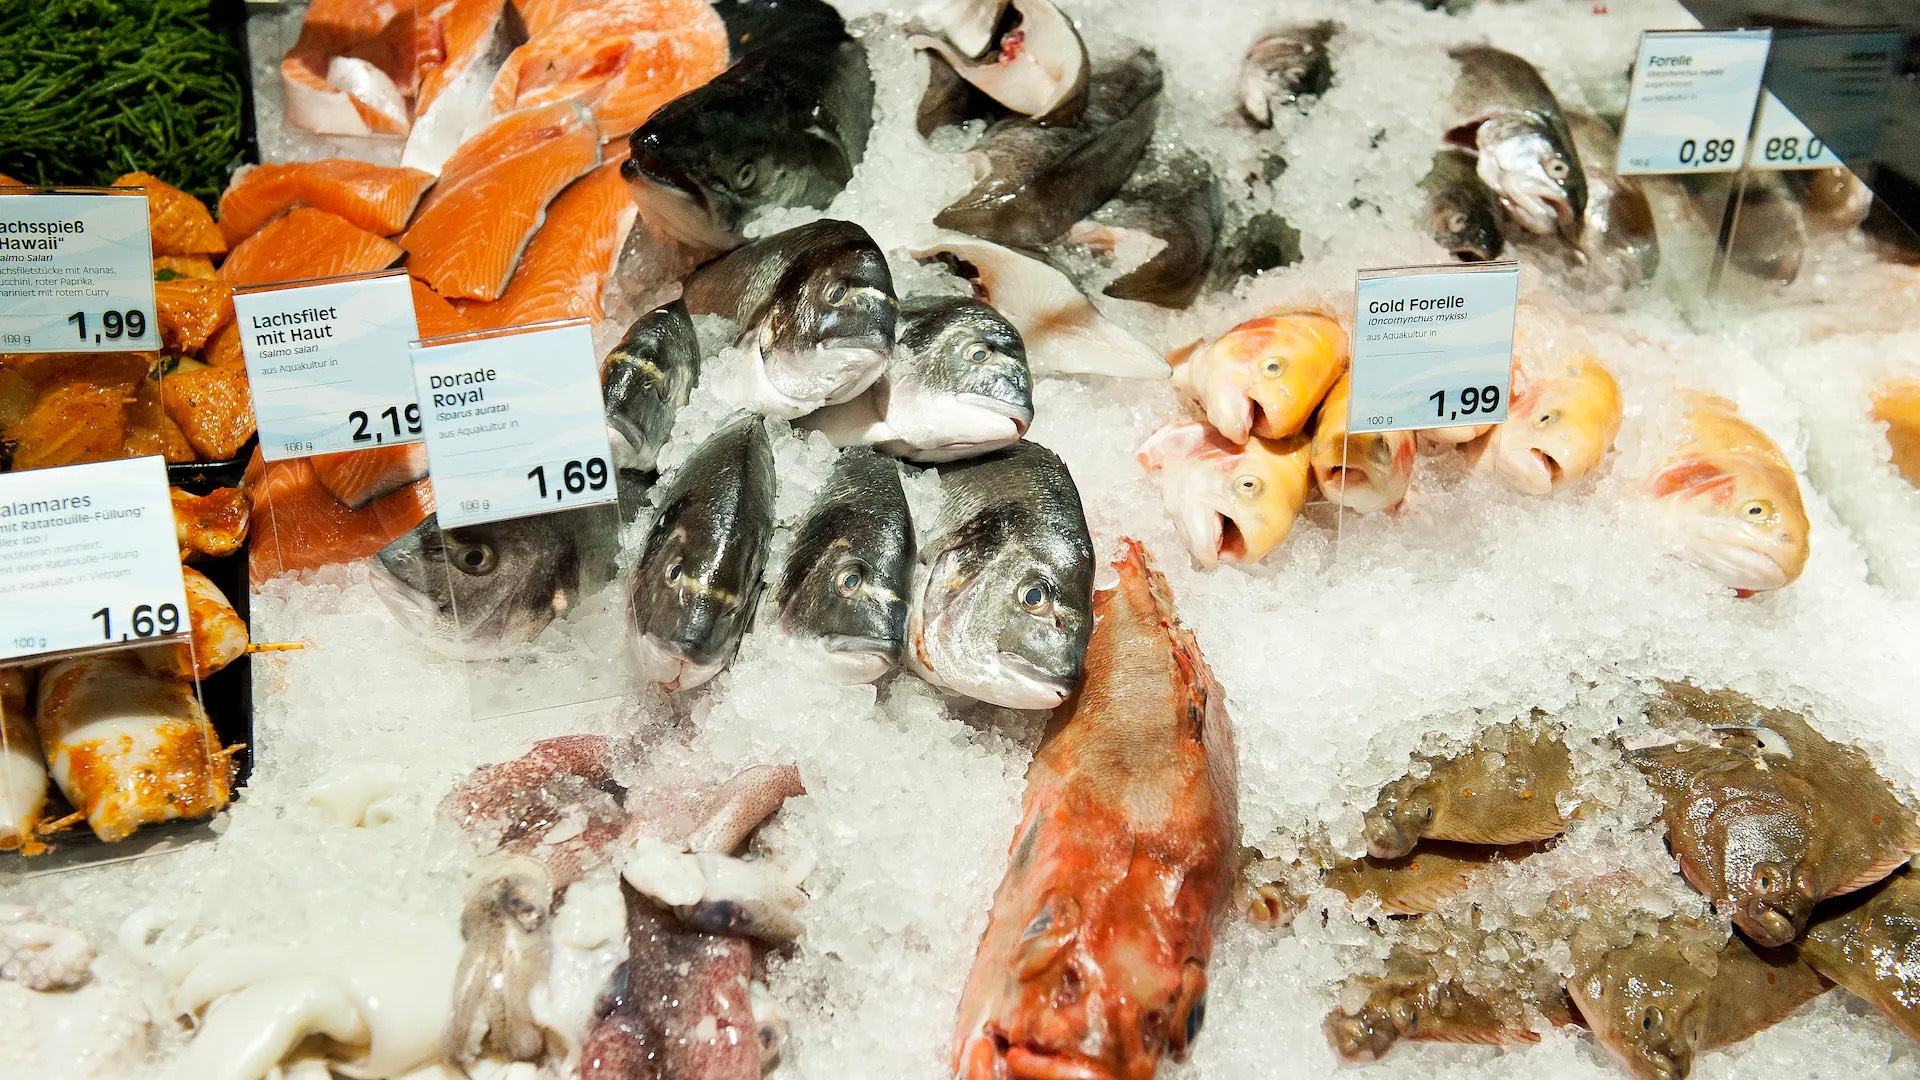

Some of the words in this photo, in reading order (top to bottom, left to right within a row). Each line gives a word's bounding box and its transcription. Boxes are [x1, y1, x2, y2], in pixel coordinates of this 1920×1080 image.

[1649, 55, 1693, 67] Forelle
[1679, 138, 1735, 167] 0,89
[65, 265, 80, 275] mit
[83, 265, 117, 276] Ananas,
[35, 278, 57, 286] roter
[60, 277, 95, 288] Paprika,
[38, 288, 53, 297] mit
[55, 288, 84, 297] rotem
[85, 288, 110, 298] Curry
[1369, 299, 1405, 314] Gold
[1409, 295, 1464, 311] Forelle
[68, 310, 146, 344] 1,99
[252, 306, 338, 329] Lachsfilet
[1368, 314, 1434, 326] (Oncorhynchus
[1435, 311, 1468, 323] mykiss)
[2, 334, 21, 345] 100
[23, 336, 31, 346] g
[256, 330, 286, 346] mit
[290, 324, 333, 342] Haut
[1366, 333, 1381, 342] aus
[1382, 329, 1428, 341] Aquakultur
[1429, 328, 1437, 337] in
[259, 347, 292, 359] (Salmo
[294, 344, 319, 356] salar)
[261, 366, 278, 376] aus
[279, 360, 327, 374] Aquakultur
[329, 357, 339, 367] in
[430, 368, 497, 390] Dorade
[433, 387, 485, 408] Royal
[1429, 385, 1500, 421] 1,99
[436, 409, 472, 422] (Sparus
[475, 403, 510, 416] aurata)
[1366, 416, 1384, 426] 100
[1386, 416, 1393, 426] g
[348, 403, 422, 443] 2,19
[438, 429, 455, 439] aus
[457, 422, 507, 438] Aquakultur
[509, 418, 519, 429] in
[284, 442, 303, 453] 100
[305, 441, 313, 453] g
[527, 457, 608, 502] 1,69
[482, 498, 490, 511] g
[92, 603, 180, 642] 1,69
[14, 638, 35, 649] 100
[39, 637, 47, 649] g
